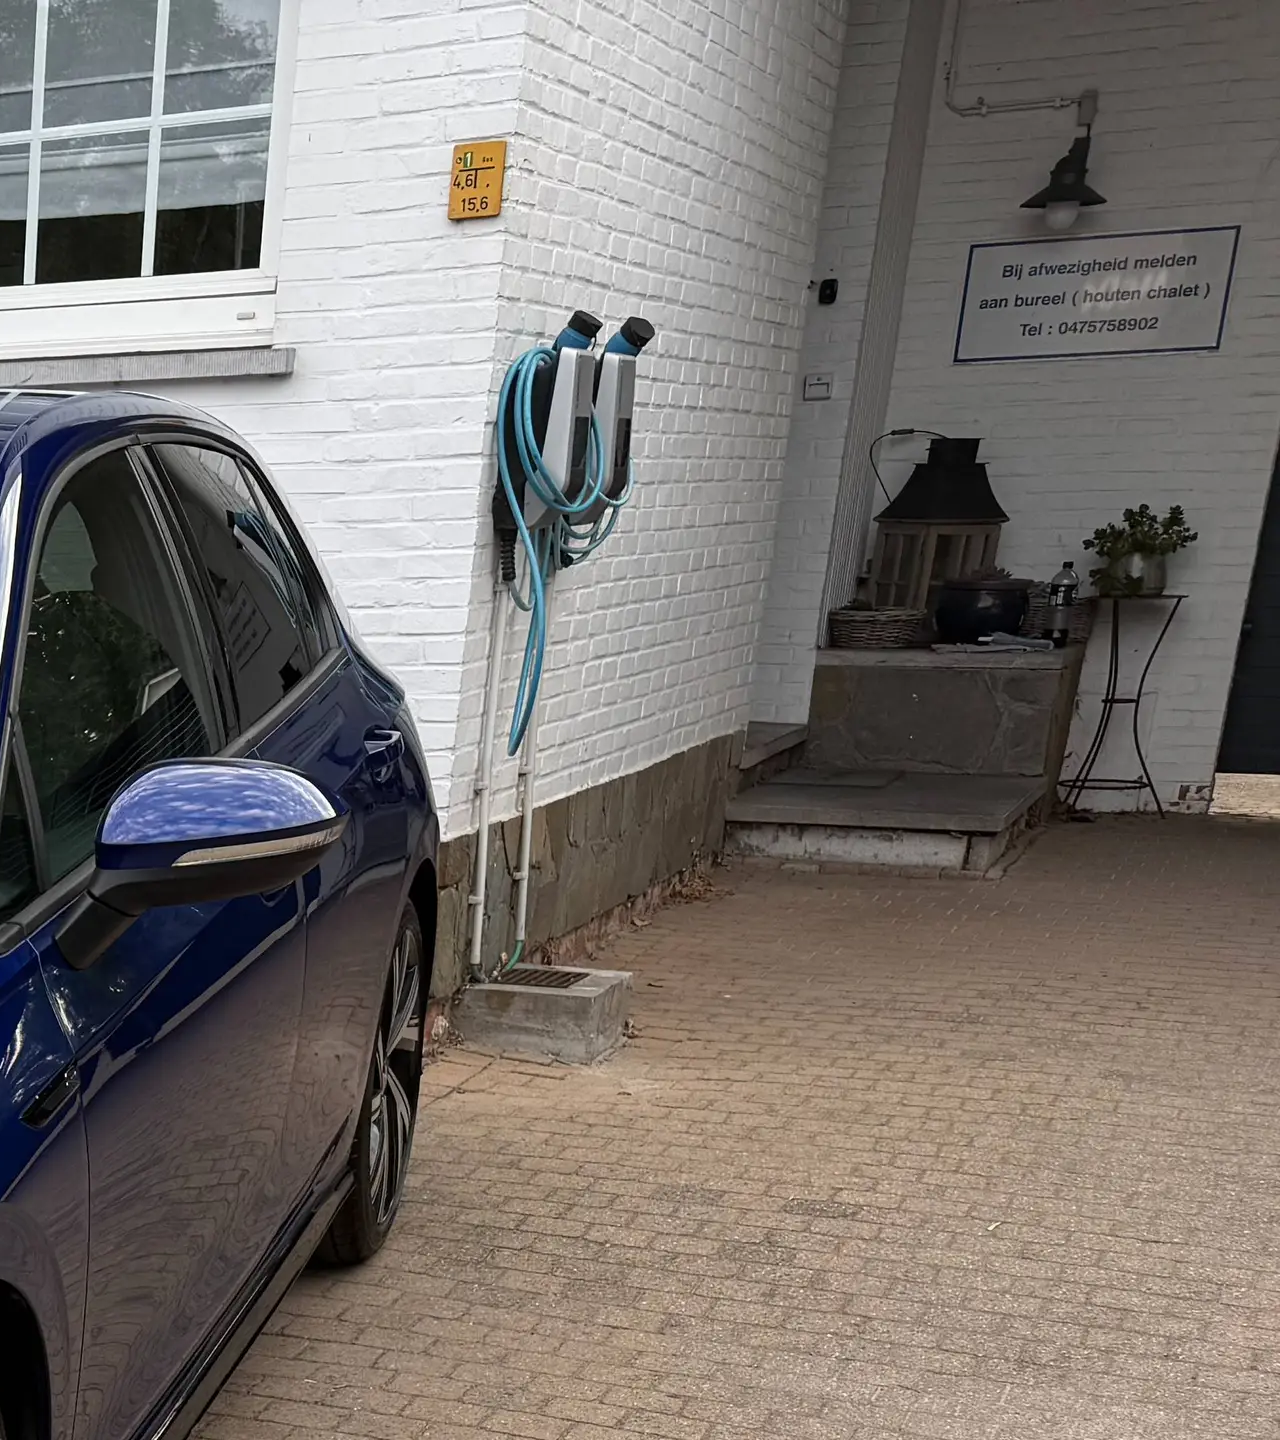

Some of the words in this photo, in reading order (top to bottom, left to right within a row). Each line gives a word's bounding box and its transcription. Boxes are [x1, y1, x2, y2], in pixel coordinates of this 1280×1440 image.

[461, 196, 488, 213] 15,6
[1002, 264, 1024, 281] Bij
[1028, 257, 1128, 276] afwezigheid
[1133, 254, 1197, 270] melden
[979, 297, 1008, 310] aan
[1014, 292, 1067, 308] bureel
[1083, 289, 1141, 304] houten
[1146, 283, 1200, 300] chalet
[1058, 317, 1159, 335] 0475758902
